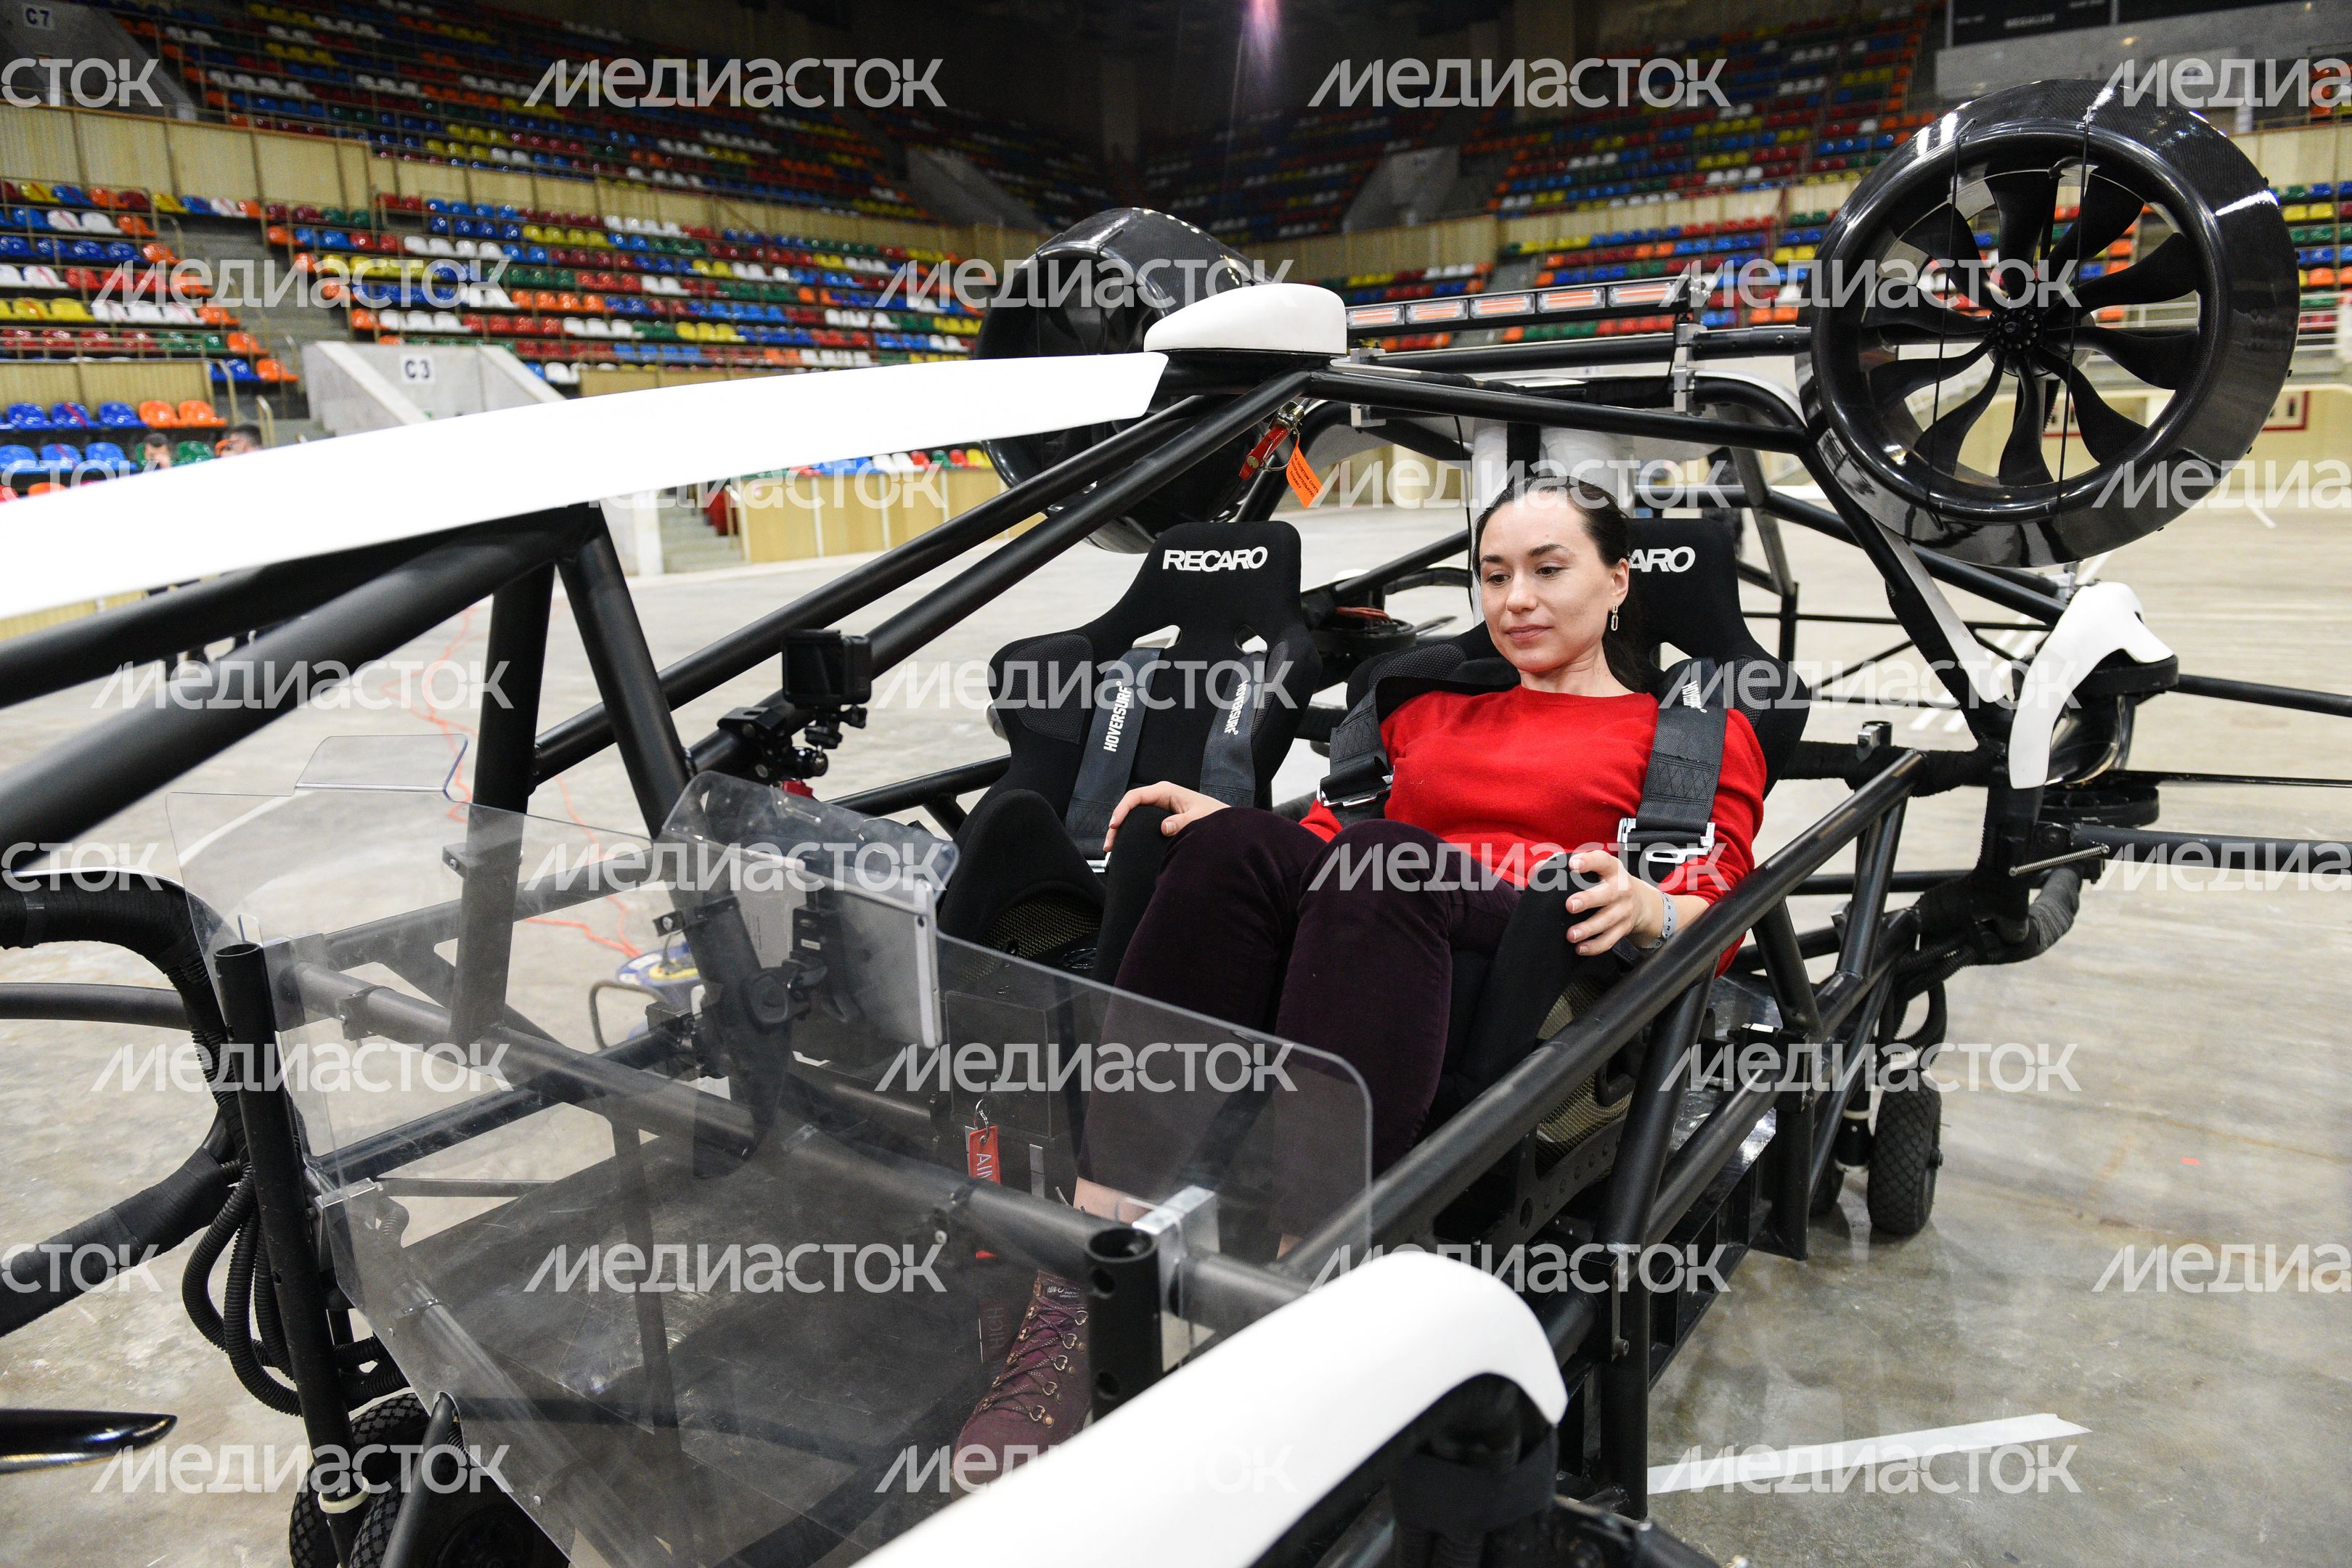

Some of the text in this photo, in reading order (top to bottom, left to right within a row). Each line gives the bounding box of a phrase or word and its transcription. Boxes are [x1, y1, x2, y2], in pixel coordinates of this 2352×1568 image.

[25, 7, 49, 26] C7
[1162, 546, 1268, 572] RECARO
[1628, 546, 1696, 573] ARO
